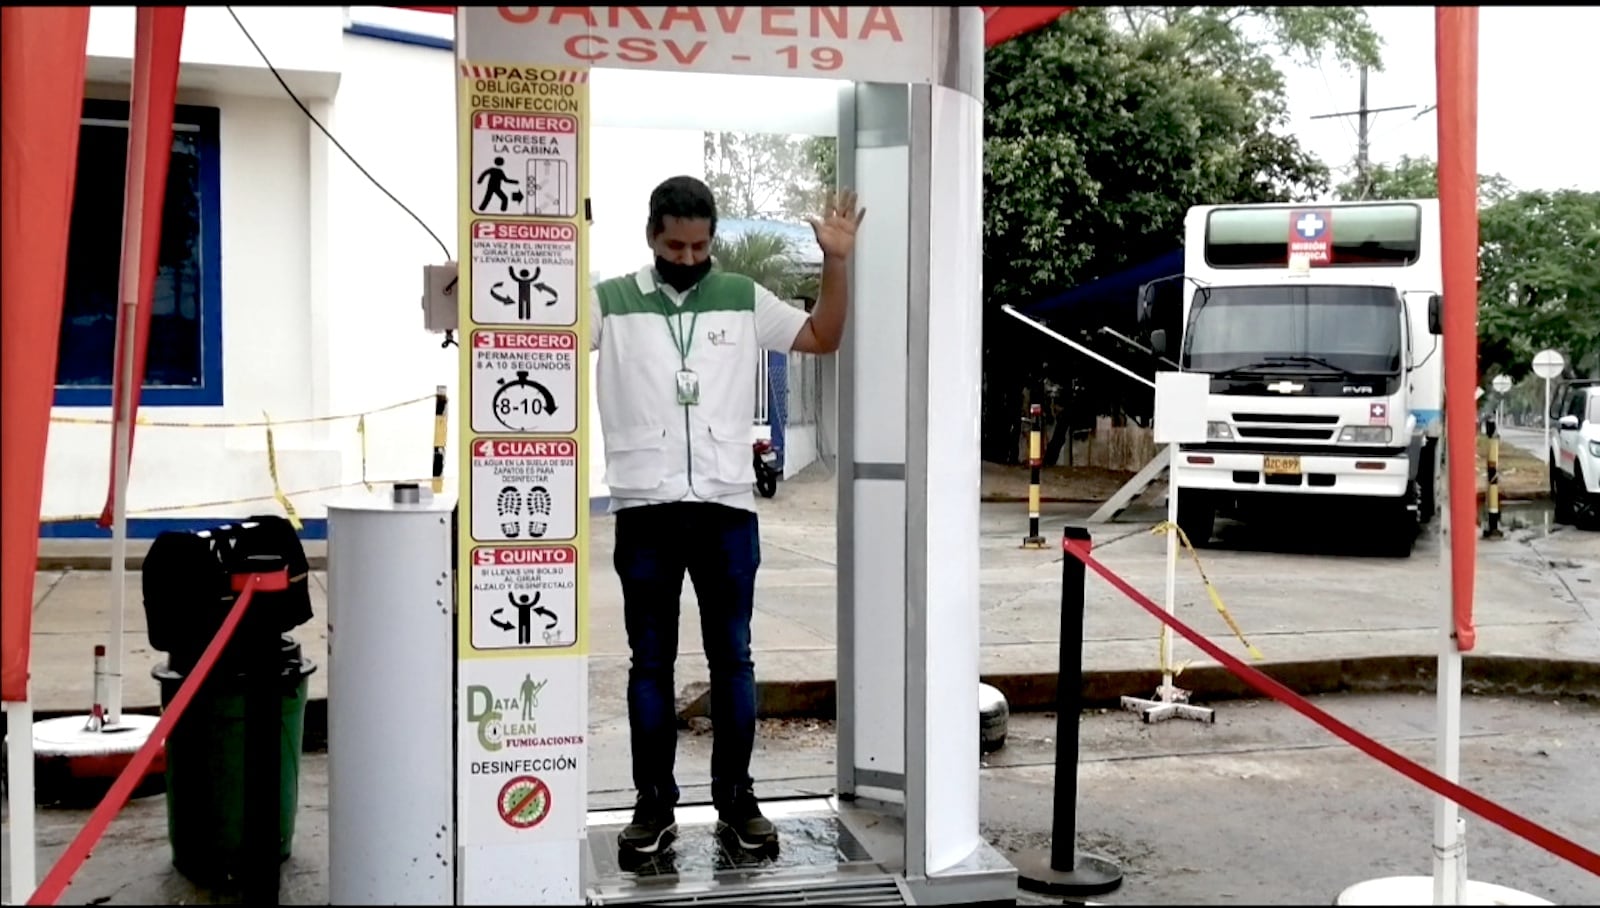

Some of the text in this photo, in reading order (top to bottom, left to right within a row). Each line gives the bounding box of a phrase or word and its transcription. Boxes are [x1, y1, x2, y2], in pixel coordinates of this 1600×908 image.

[564, 34, 708, 65] CSV
[775, 45, 844, 71] 19
[493, 66, 557, 82] PASO
[475, 79, 575, 97] OBLIGATORIO
[471, 94, 578, 112] DESINFECCIÓN
[480, 114, 572, 131] 1 PRIMERO
[492, 134, 558, 145] INGRESE A
[494, 144, 560, 155] LA CABINA
[478, 222, 572, 239] 2 SEGUNDO
[524, 257, 539, 265] LOS
[542, 258, 574, 266] BRAZOS
[478, 332, 571, 348] 3 TERCERO
[478, 351, 570, 361] PERMANECER DE
[496, 361, 508, 370] 10
[511, 361, 571, 370] SEGUNDOS
[479, 440, 571, 457] 4 CUARTO
[493, 467, 524, 475] ZAPATOS
[500, 550, 567, 563] QUINTO
[491, 568, 521, 576] LLEVAS
[474, 583, 506, 591] ALZALO
[506, 736, 583, 748] FUMIGACIONES
[471, 755, 577, 774] DESINFECCIÓN
